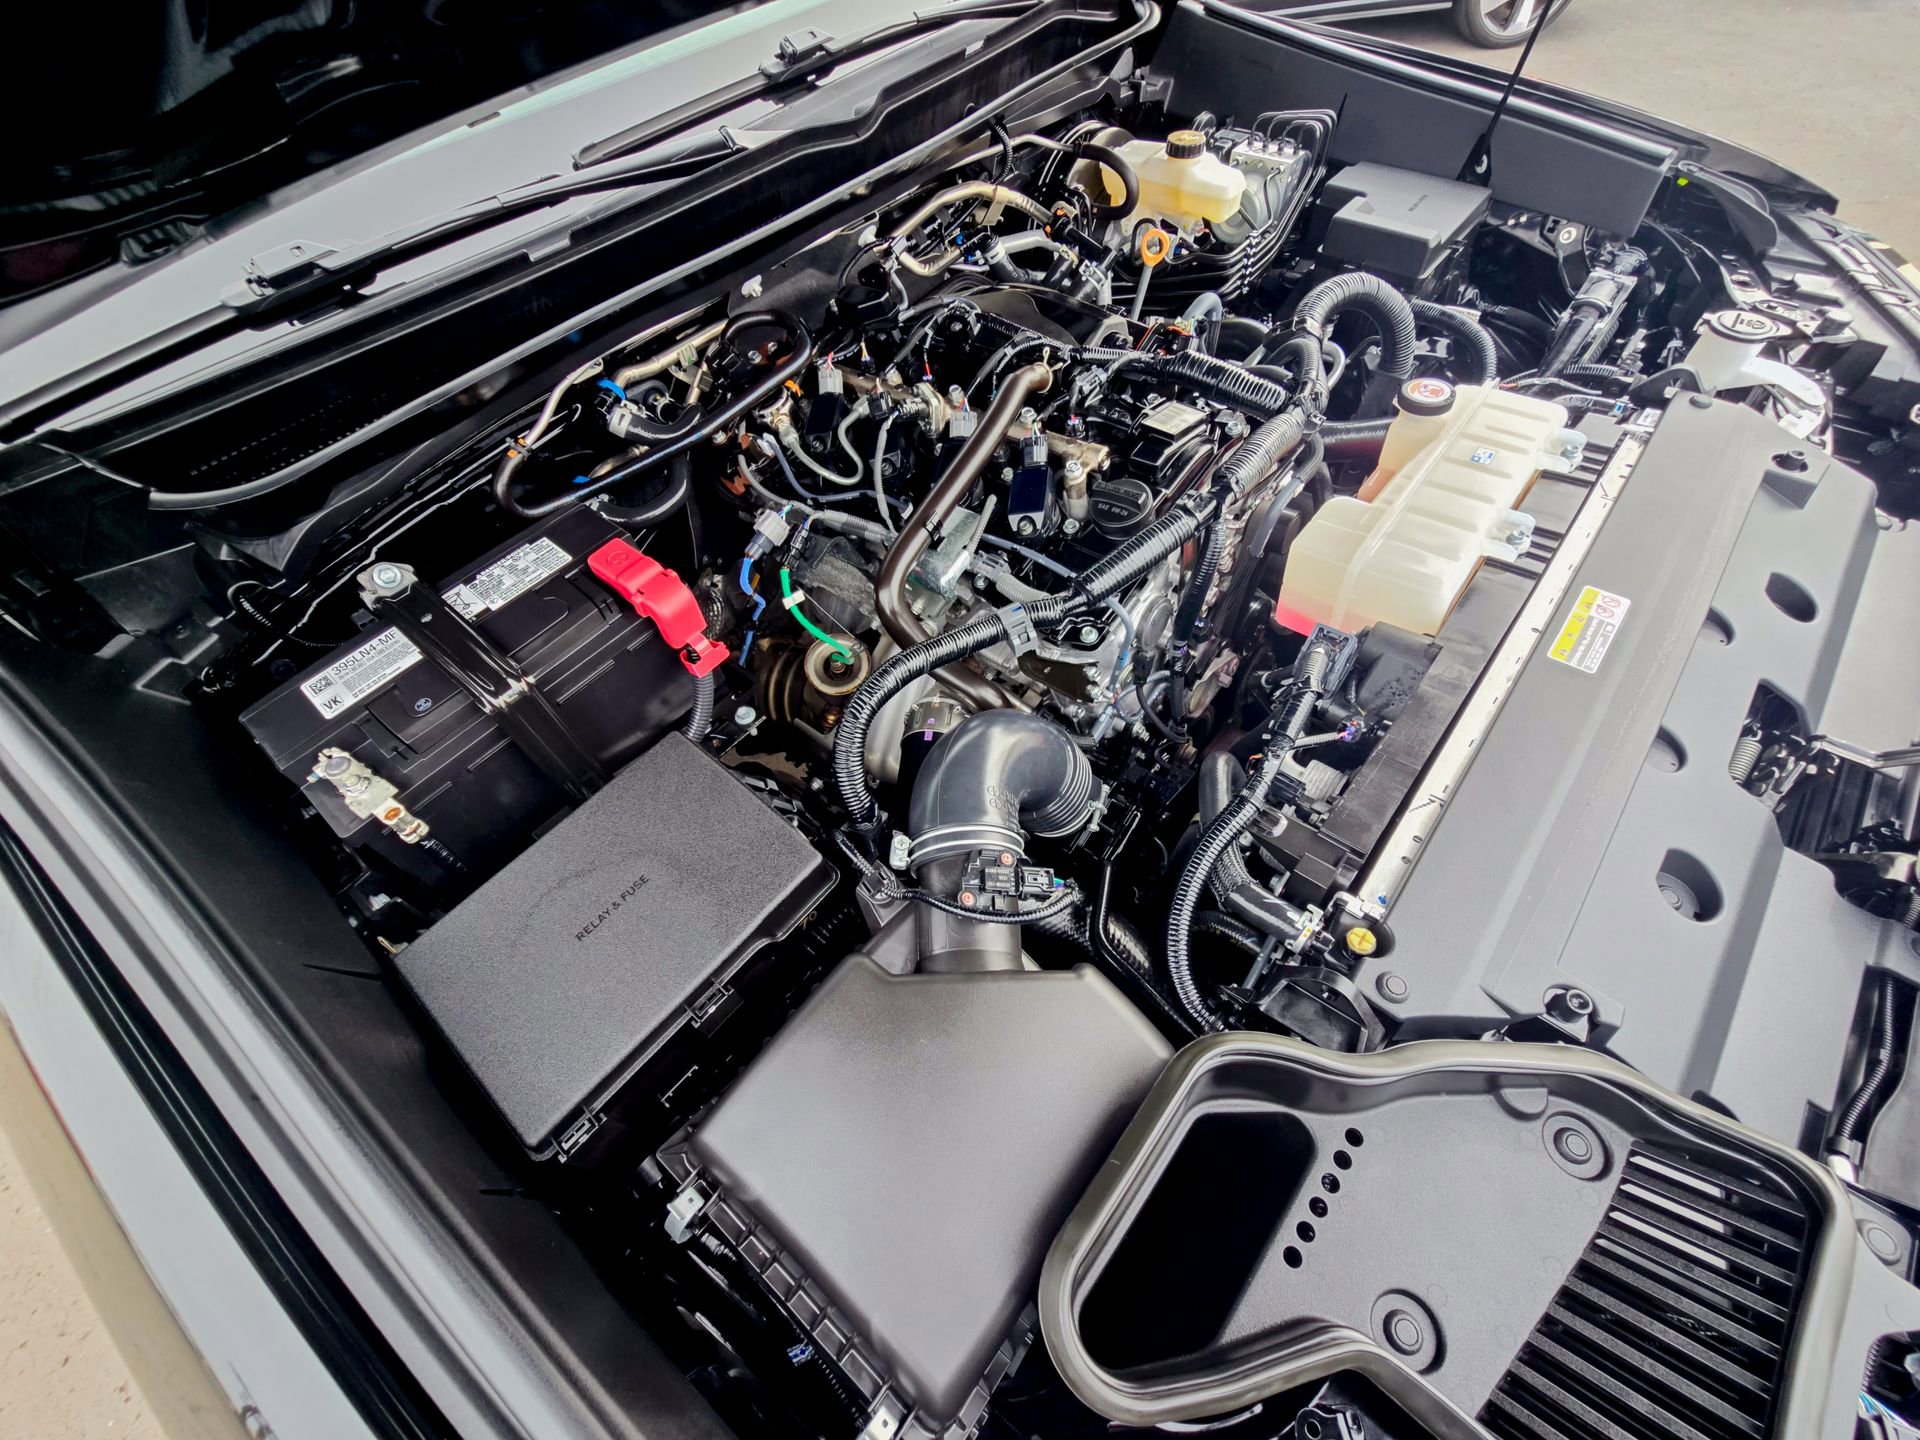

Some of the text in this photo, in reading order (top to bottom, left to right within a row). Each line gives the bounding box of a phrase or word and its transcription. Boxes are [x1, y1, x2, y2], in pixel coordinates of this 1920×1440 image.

[331, 630, 397, 676] 395LN4-MF
[323, 695, 342, 710] VK
[576, 874, 649, 941] RELAY & FUSE
